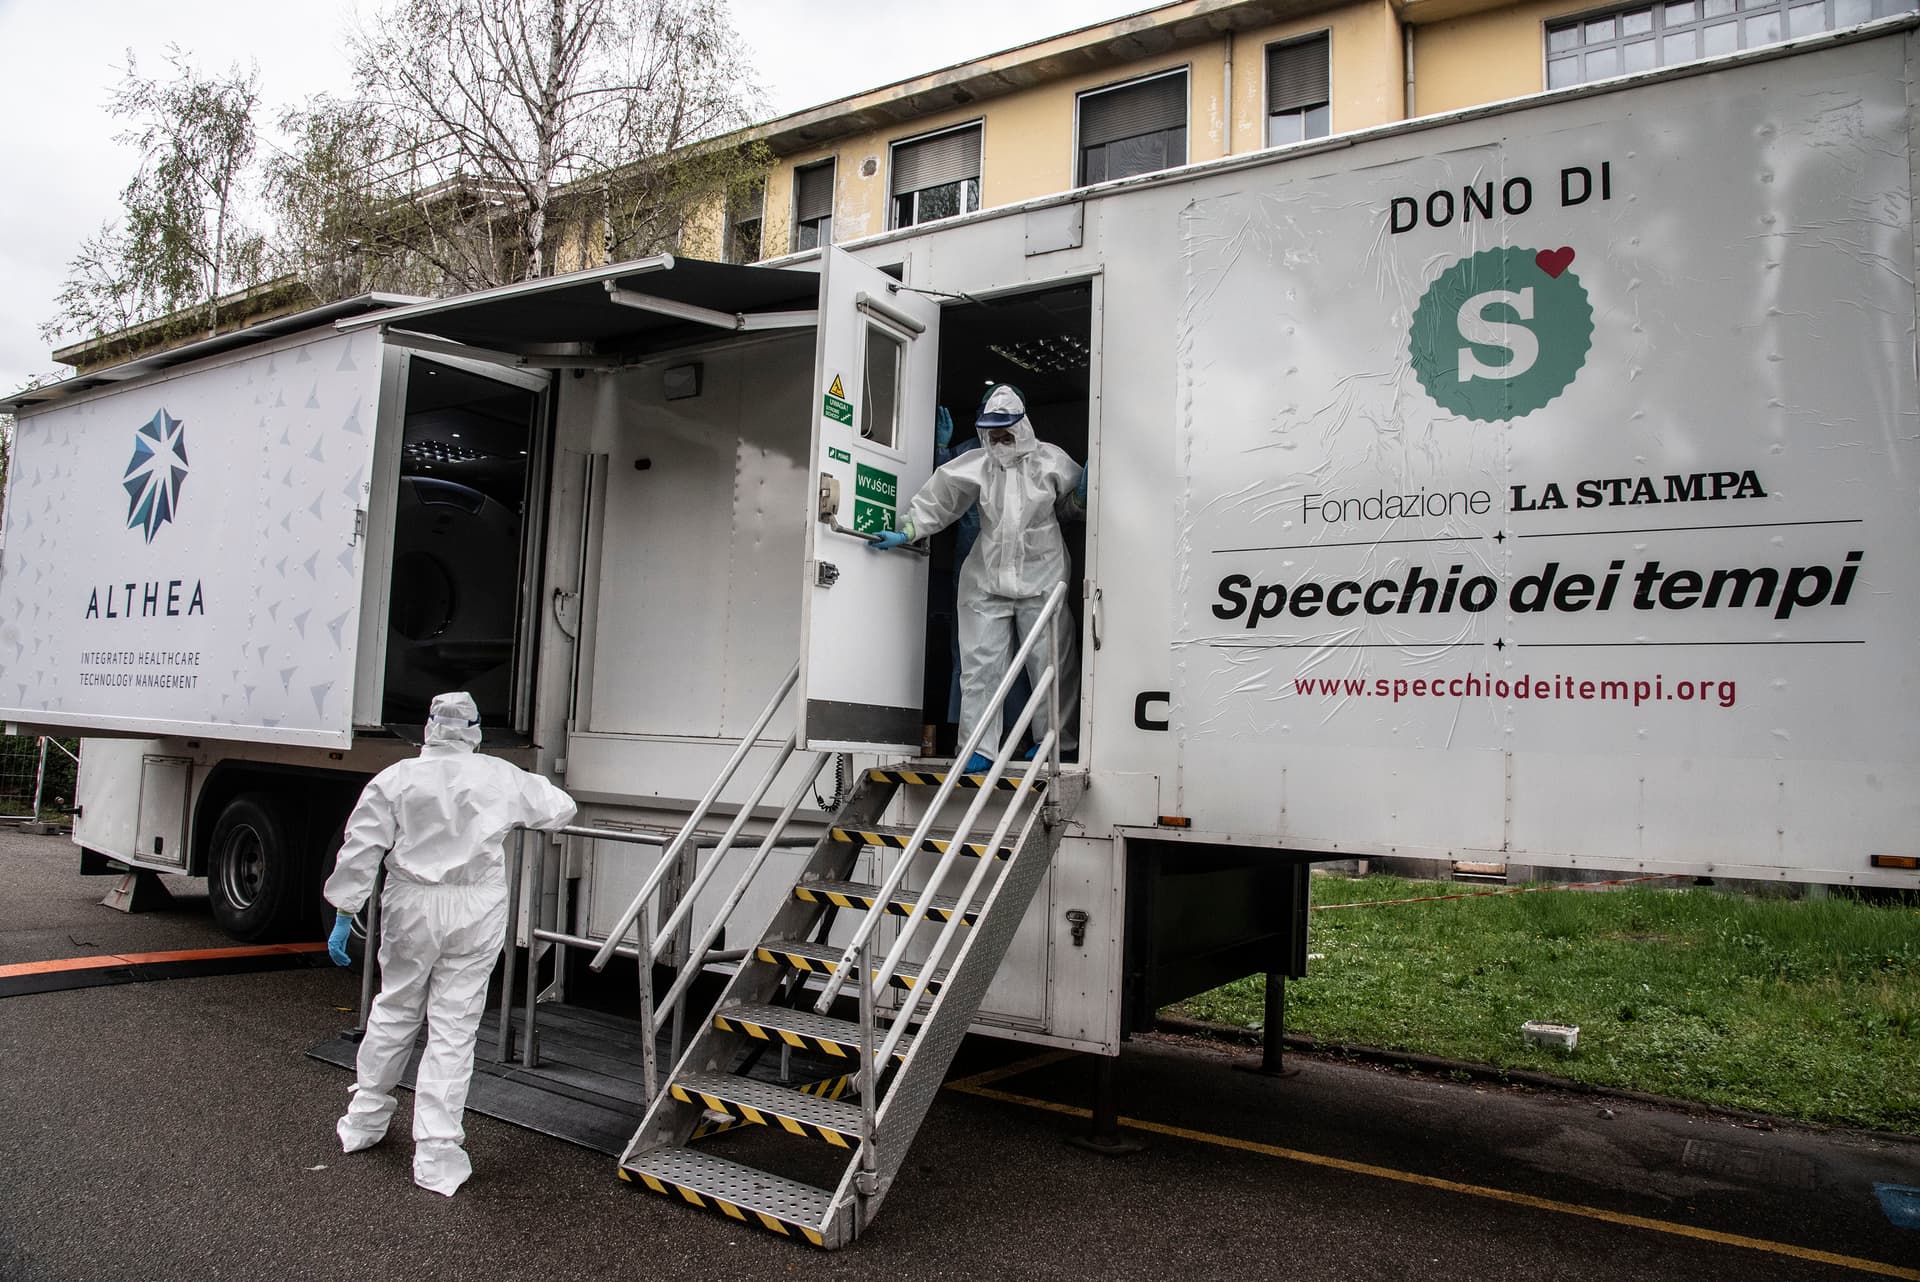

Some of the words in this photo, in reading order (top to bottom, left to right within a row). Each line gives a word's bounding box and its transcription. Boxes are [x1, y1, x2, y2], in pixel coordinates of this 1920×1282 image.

[1390, 176, 1533, 235] DONO
[1560, 161, 1611, 208] DI
[1456, 286, 1539, 383] S
[857, 474, 896, 497] WYJŚCIE
[1303, 486, 1491, 525] Fondazione
[1509, 484, 1569, 512] LA
[1576, 470, 1768, 509] STAMPA
[85, 578, 205, 619] ALTHEA
[1211, 565, 1498, 629] Specchio
[1509, 559, 1626, 613] dei
[1633, 550, 1865, 620] tempi
[80, 651, 135, 665] INTEGRATED
[138, 651, 201, 666] HEALTHCARE
[80, 672, 133, 687] TECHNOLOGY
[135, 674, 198, 689] MANAGEMENT
[1293, 672, 1737, 708] www.specchiodeitempi.org
